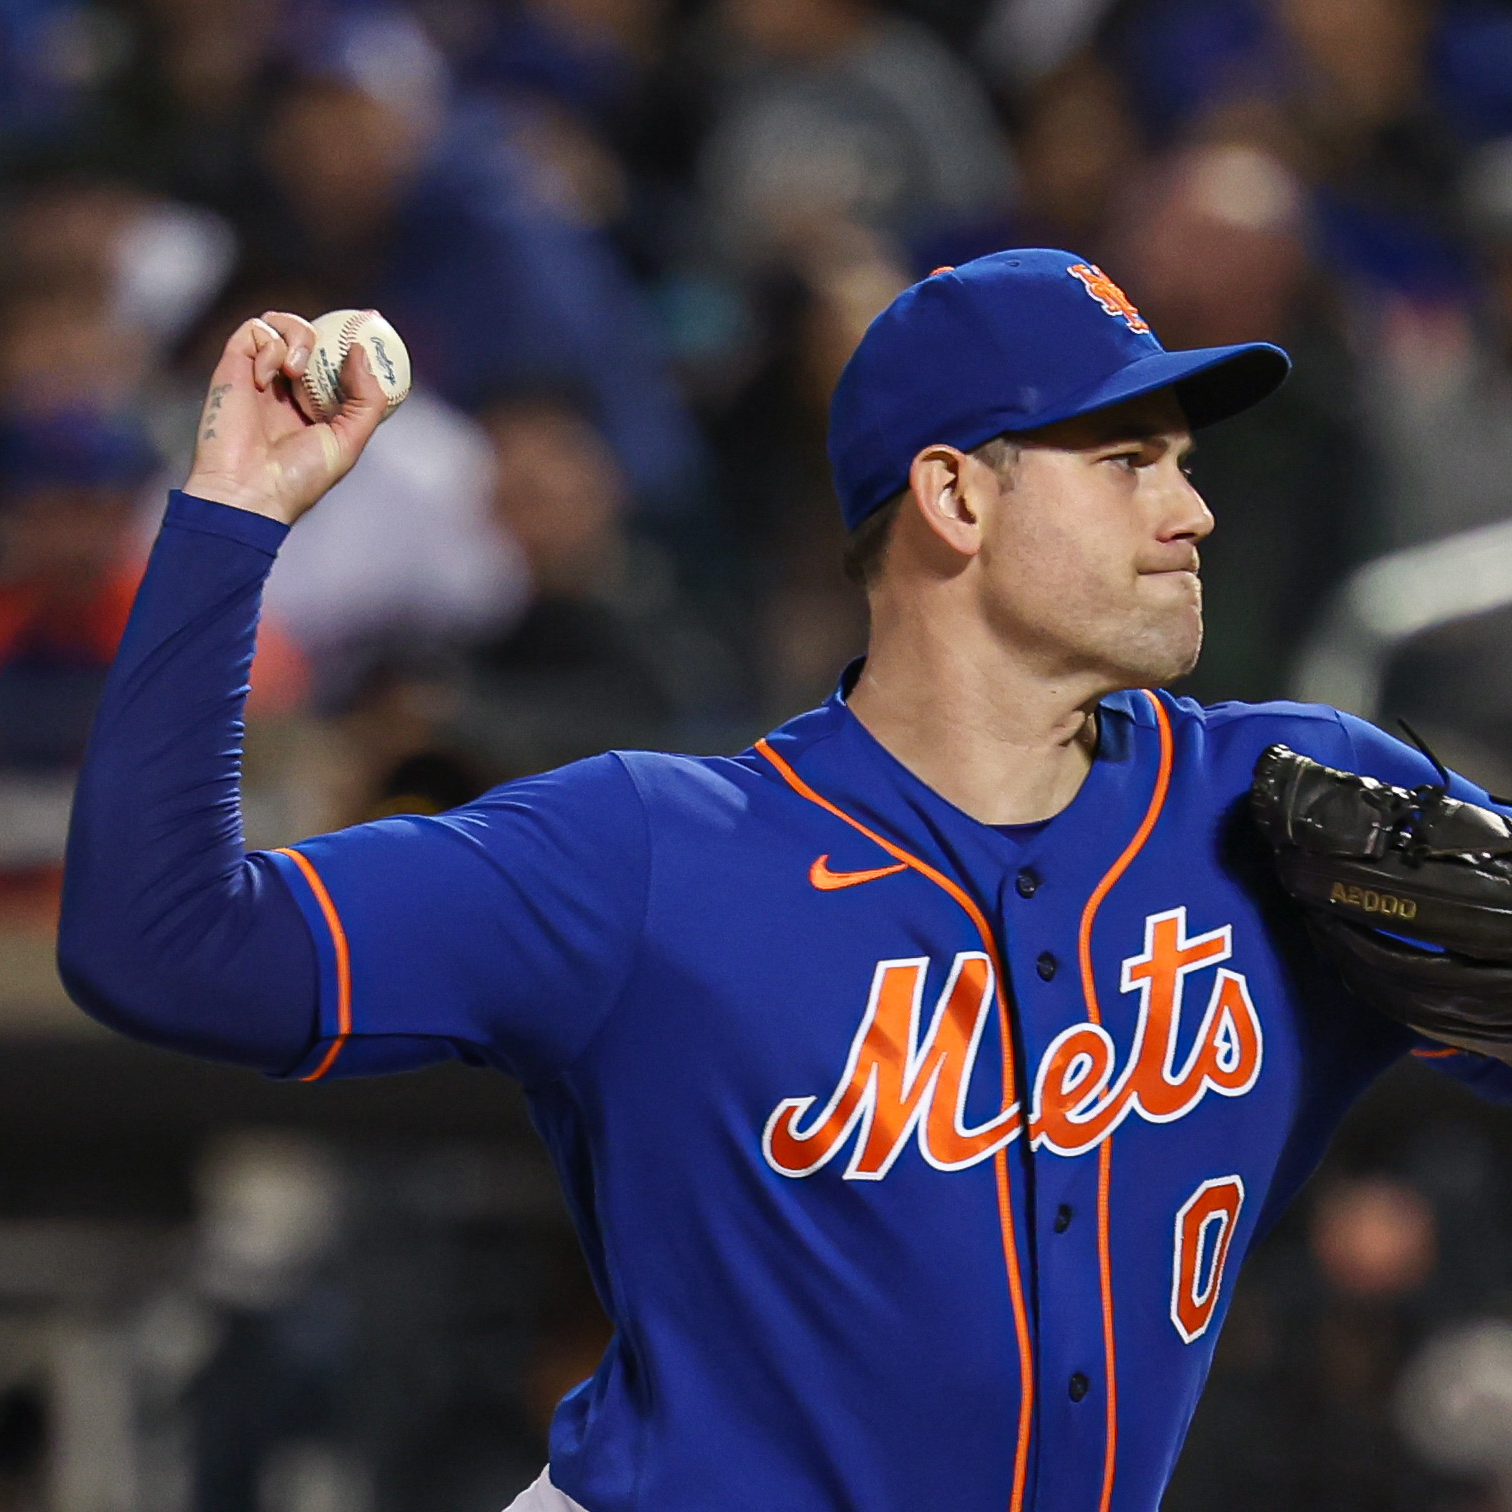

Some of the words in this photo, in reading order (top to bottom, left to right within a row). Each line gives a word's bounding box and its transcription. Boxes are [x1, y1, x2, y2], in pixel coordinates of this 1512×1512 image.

[1330, 882, 1417, 919] A2000
[761, 905, 1264, 1181] Mets
[1169, 1174, 1245, 1345] 0
